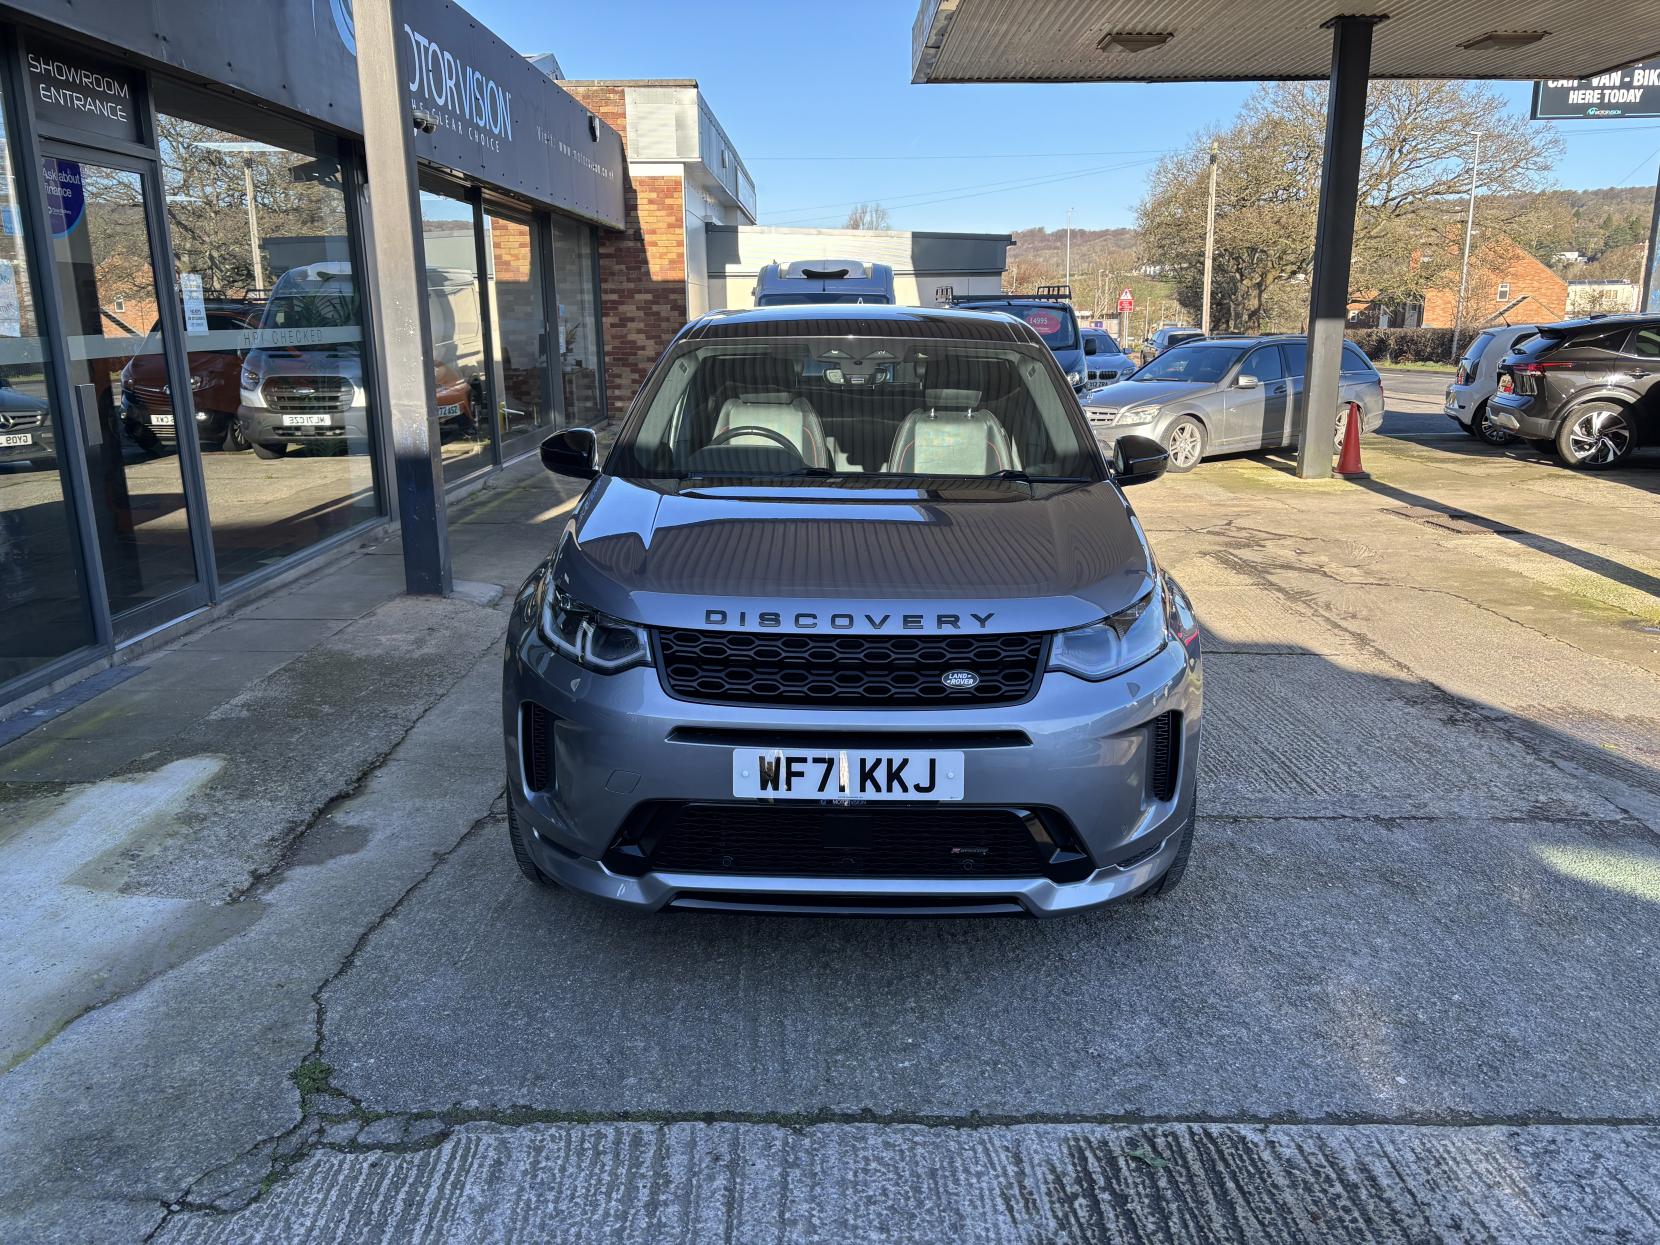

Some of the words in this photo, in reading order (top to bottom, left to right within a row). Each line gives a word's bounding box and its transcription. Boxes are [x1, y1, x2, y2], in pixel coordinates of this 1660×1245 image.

[28, 53, 129, 99] SHOWROOM
[1633, 69, 1660, 86] BIK
[40, 83, 128, 122] ENTRANCE
[1568, 89, 1602, 104] HERE
[1603, 88, 1644, 103] TODAY
[468, 127, 500, 153] CHOICE
[59, 170, 81, 185] about
[271, 329, 322, 345] CHECKED
[705, 609, 995, 630] DISCOVERY
[859, 757, 937, 794] KKJ
